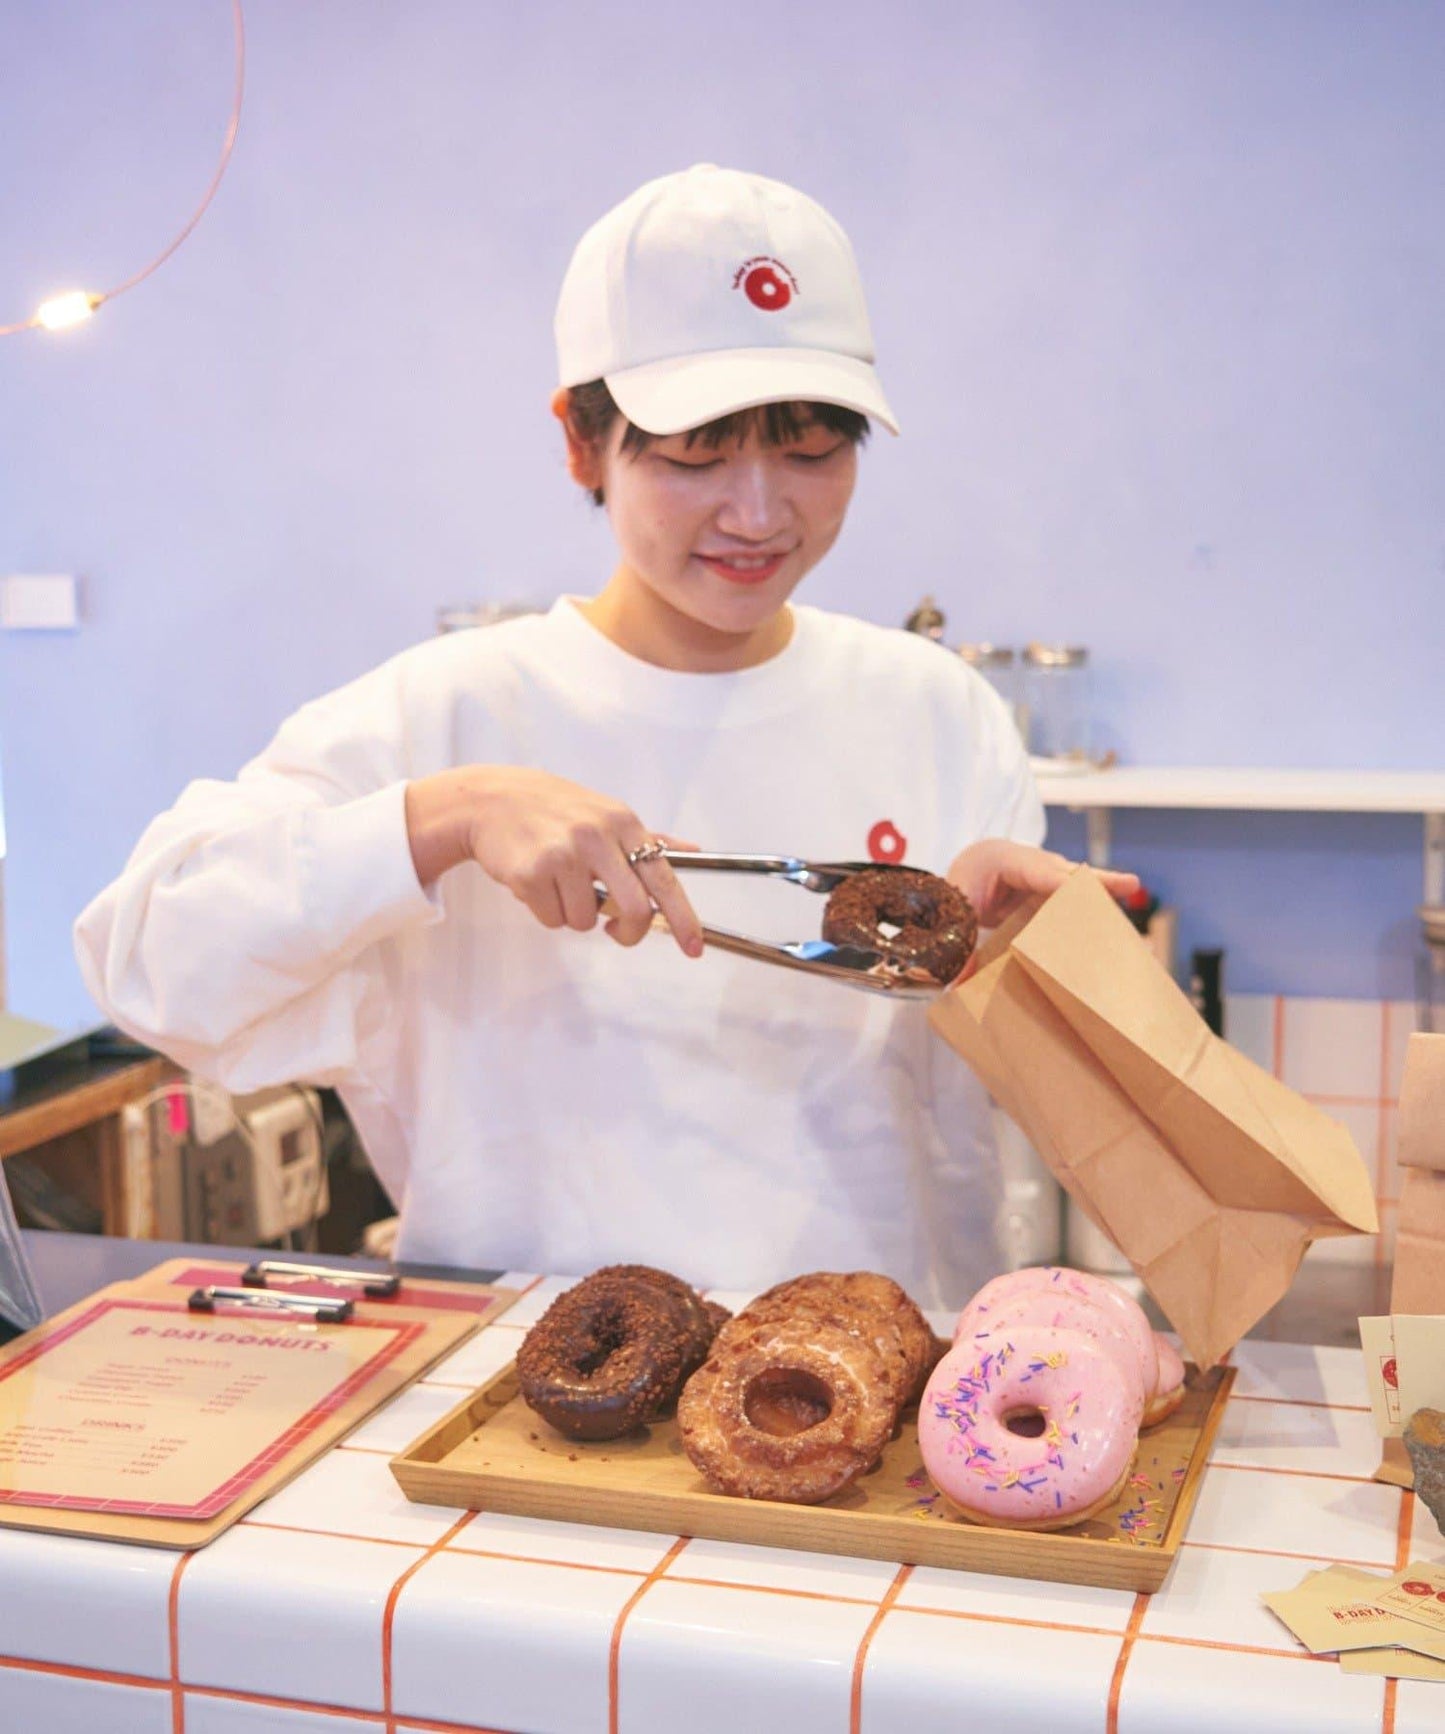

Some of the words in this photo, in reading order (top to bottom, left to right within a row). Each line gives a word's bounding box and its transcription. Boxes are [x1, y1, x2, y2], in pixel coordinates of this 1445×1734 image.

[131, 1326, 214, 1341] B-DAY
[215, 1333, 332, 1351] DONUTS
[1333, 1608, 1373, 1620] B-DAY
